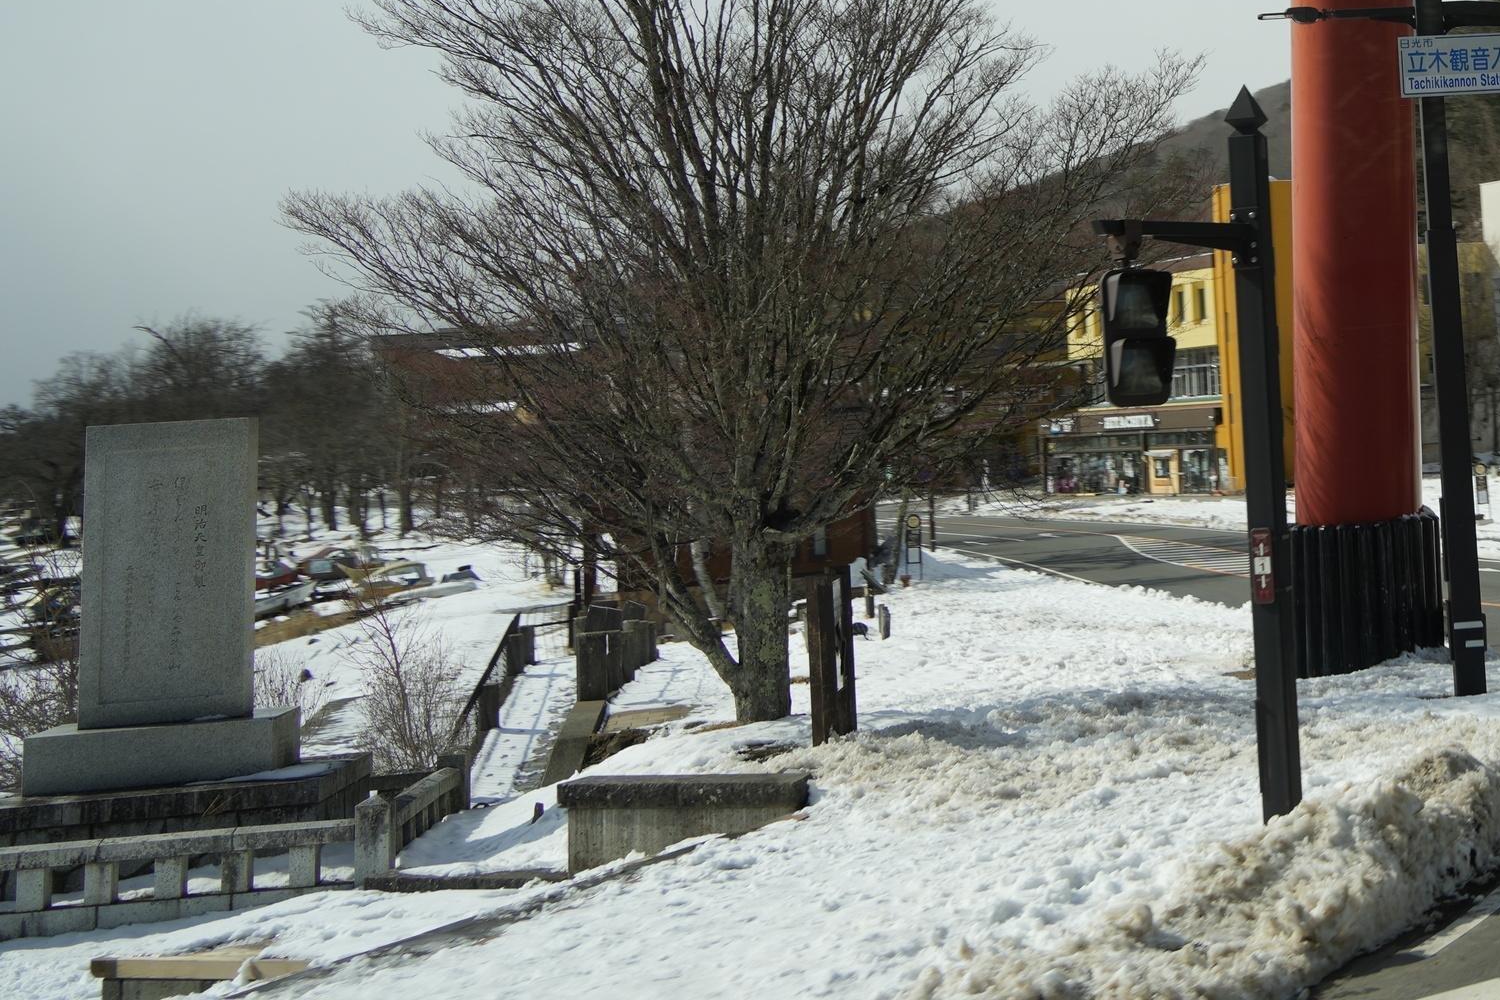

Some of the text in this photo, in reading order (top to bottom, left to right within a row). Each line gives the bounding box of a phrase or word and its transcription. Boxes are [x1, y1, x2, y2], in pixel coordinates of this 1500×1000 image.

[1400, 38, 1433, 49] 日光市
[1408, 75, 1477, 90] Tachikikannon
